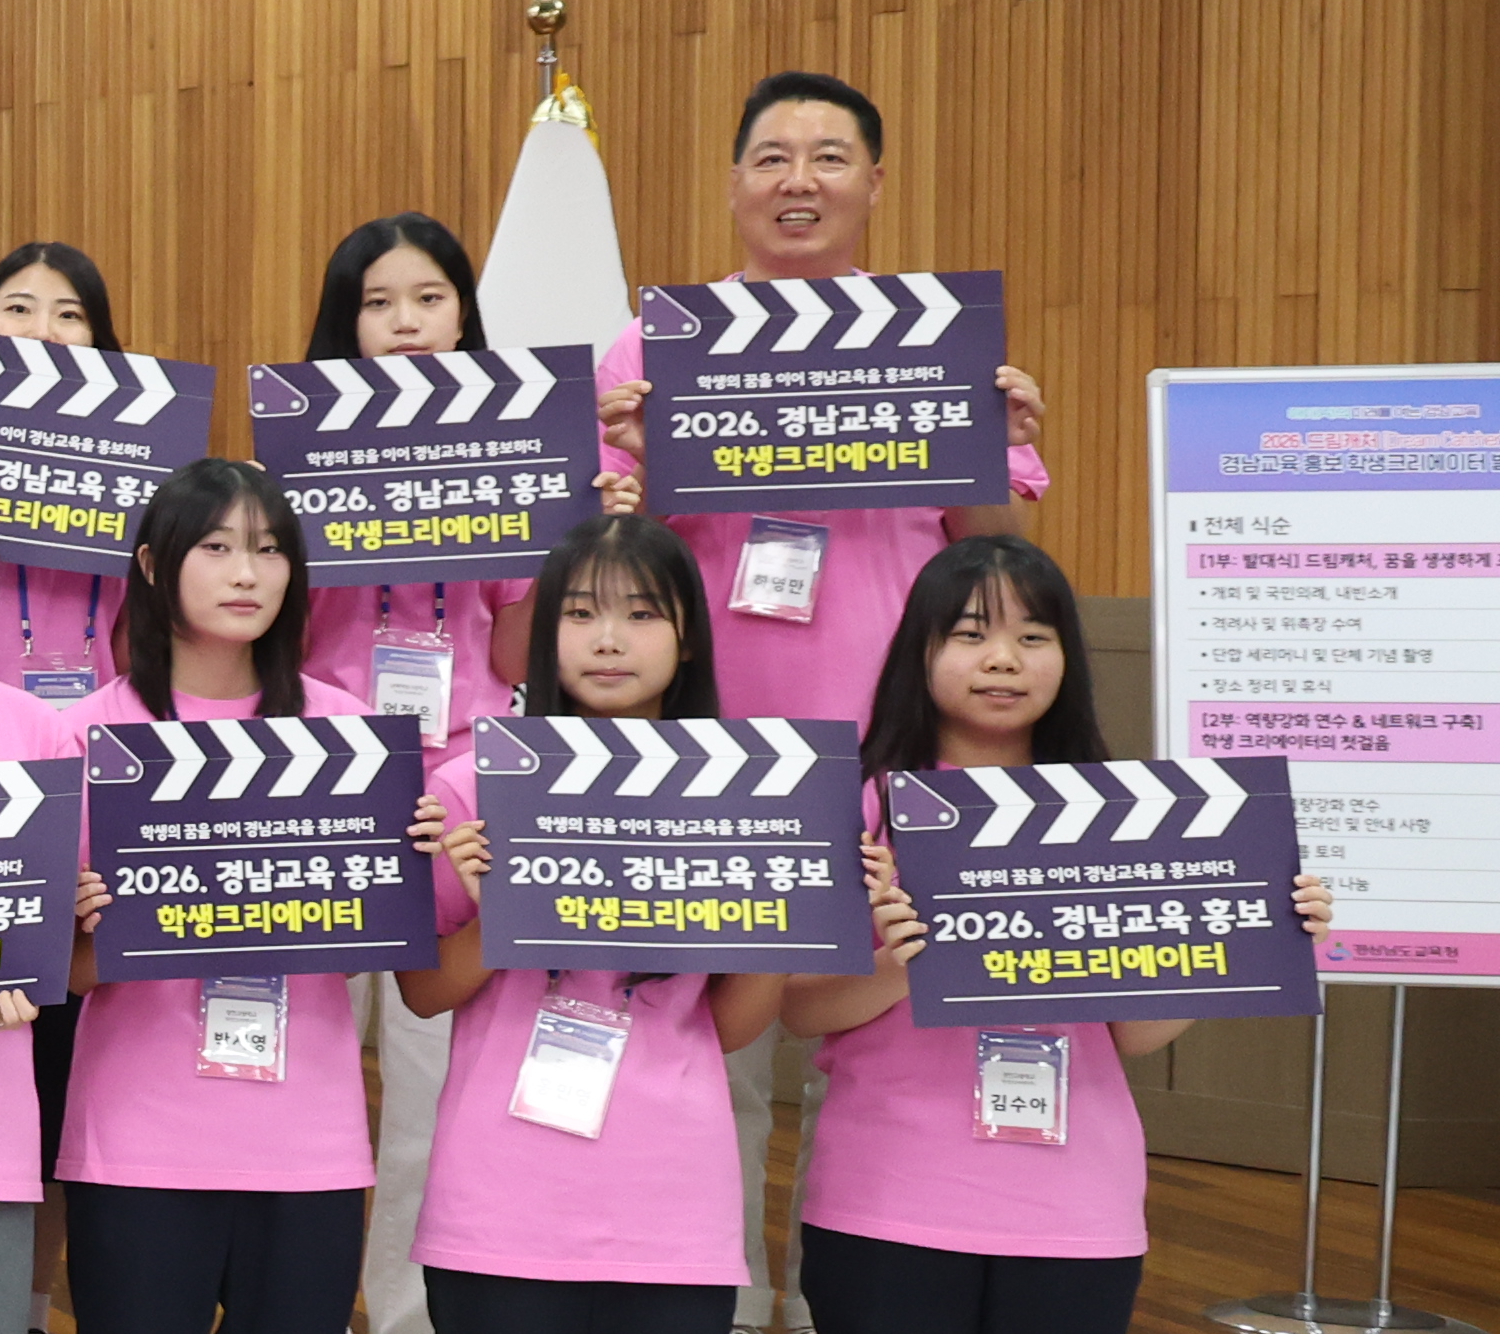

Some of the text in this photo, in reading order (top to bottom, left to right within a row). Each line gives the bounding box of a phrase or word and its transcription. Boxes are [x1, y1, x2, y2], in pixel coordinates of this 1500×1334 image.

[697, 366, 944, 390] 학생의 꿈을 이어 경남교육을 홍보하다
[671, 401, 972, 438] 2026. 경남교육 홍보
[713, 440, 927, 476] 학생크리에이터
[1220, 454, 1300, 474] 경남교육
[1304, 454, 1342, 474] 홍보
[1348, 454, 1485, 474] 학생크리에이터
[1204, 517, 1291, 535] 전체 식순
[1384, 553, 1417, 569] 꿈을
[1422, 553, 1491, 569] 생생하게
[1315, 713, 1347, 729] 연수
[1352, 715, 1365, 728] &
[1293, 799, 1345, 813] 량강화
[536, 816, 801, 836] 학생의 꿈을 이어 경남교육을 홍보하다
[508, 856, 833, 891] 2026. 경남교육 홍보
[556, 896, 787, 931] 학생크리에이터
[990, 1094, 1048, 1115] 김수아
